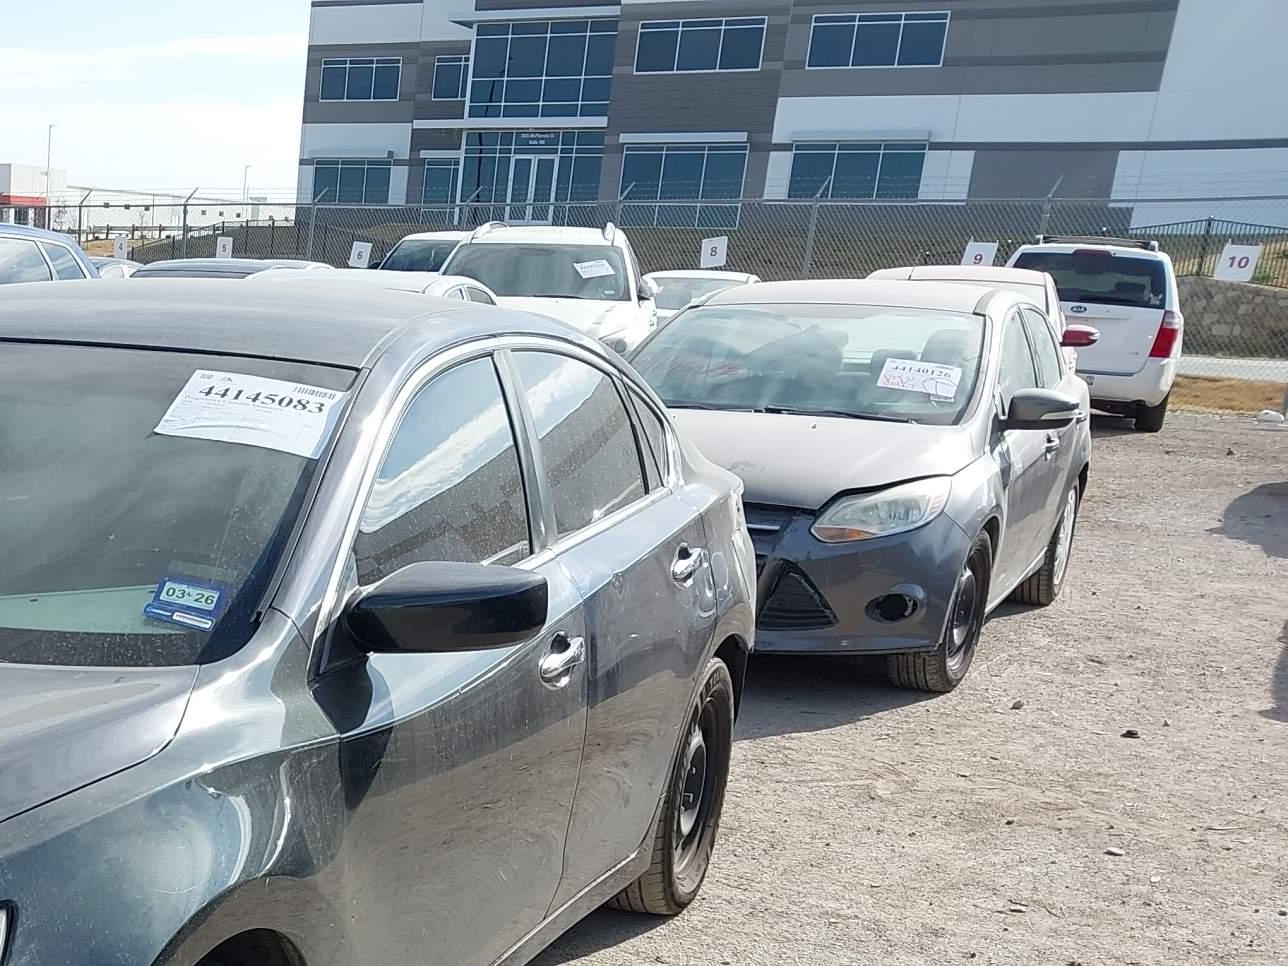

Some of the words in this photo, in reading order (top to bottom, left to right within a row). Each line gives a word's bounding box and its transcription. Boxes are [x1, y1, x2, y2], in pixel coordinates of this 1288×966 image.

[356, 250, 363, 260] 6
[709, 246, 718, 257] 8
[972, 253, 984, 265] 9
[1228, 255, 1250, 269] 10
[891, 365, 952, 379] 44140126
[199, 384, 326, 415] 44145083
